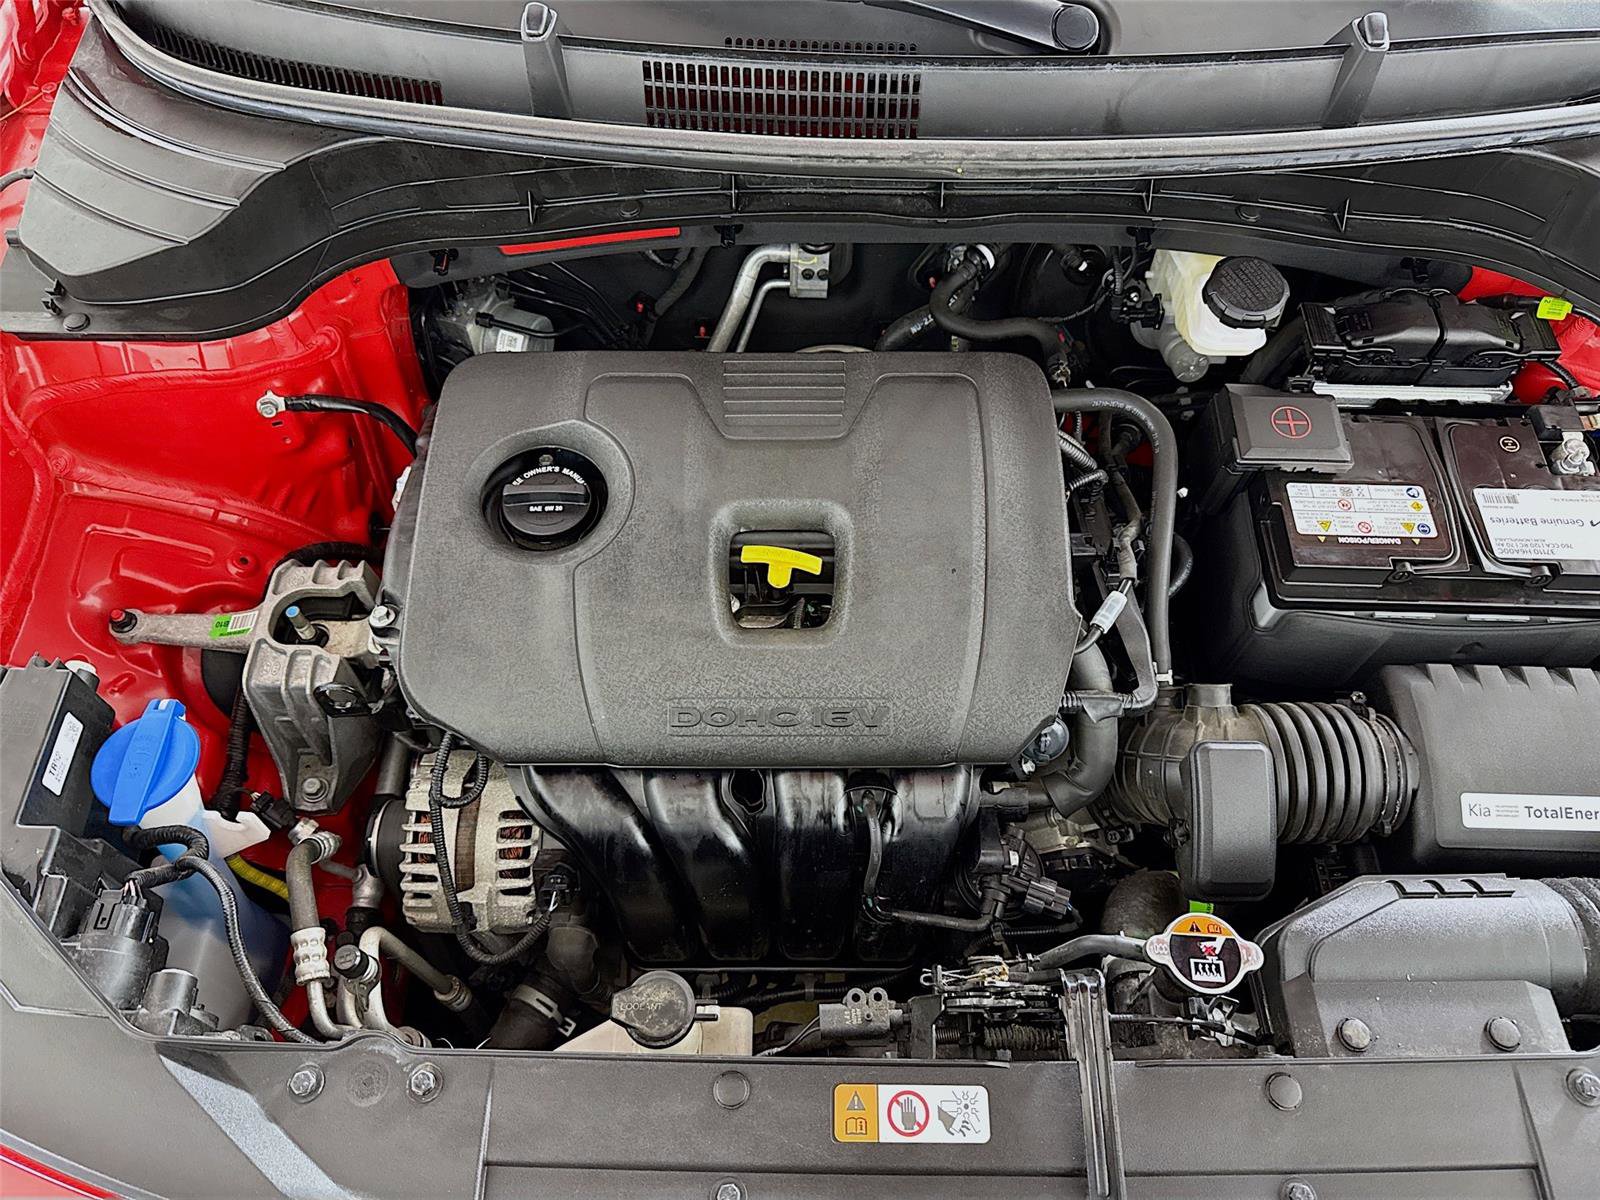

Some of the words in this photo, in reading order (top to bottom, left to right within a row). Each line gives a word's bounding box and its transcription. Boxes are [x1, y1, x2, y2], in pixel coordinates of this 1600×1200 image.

[523, 466, 560, 478] OWNER'S
[562, 468, 587, 485] MANU
[1489, 516, 1538, 526] Batteries
[1540, 518, 1585, 527] Genuine
[671, 706, 801, 728] DOHC
[811, 706, 890, 728] 16V
[1468, 803, 1491, 817] Kia
[620, 1002, 663, 1011] COOLANT
